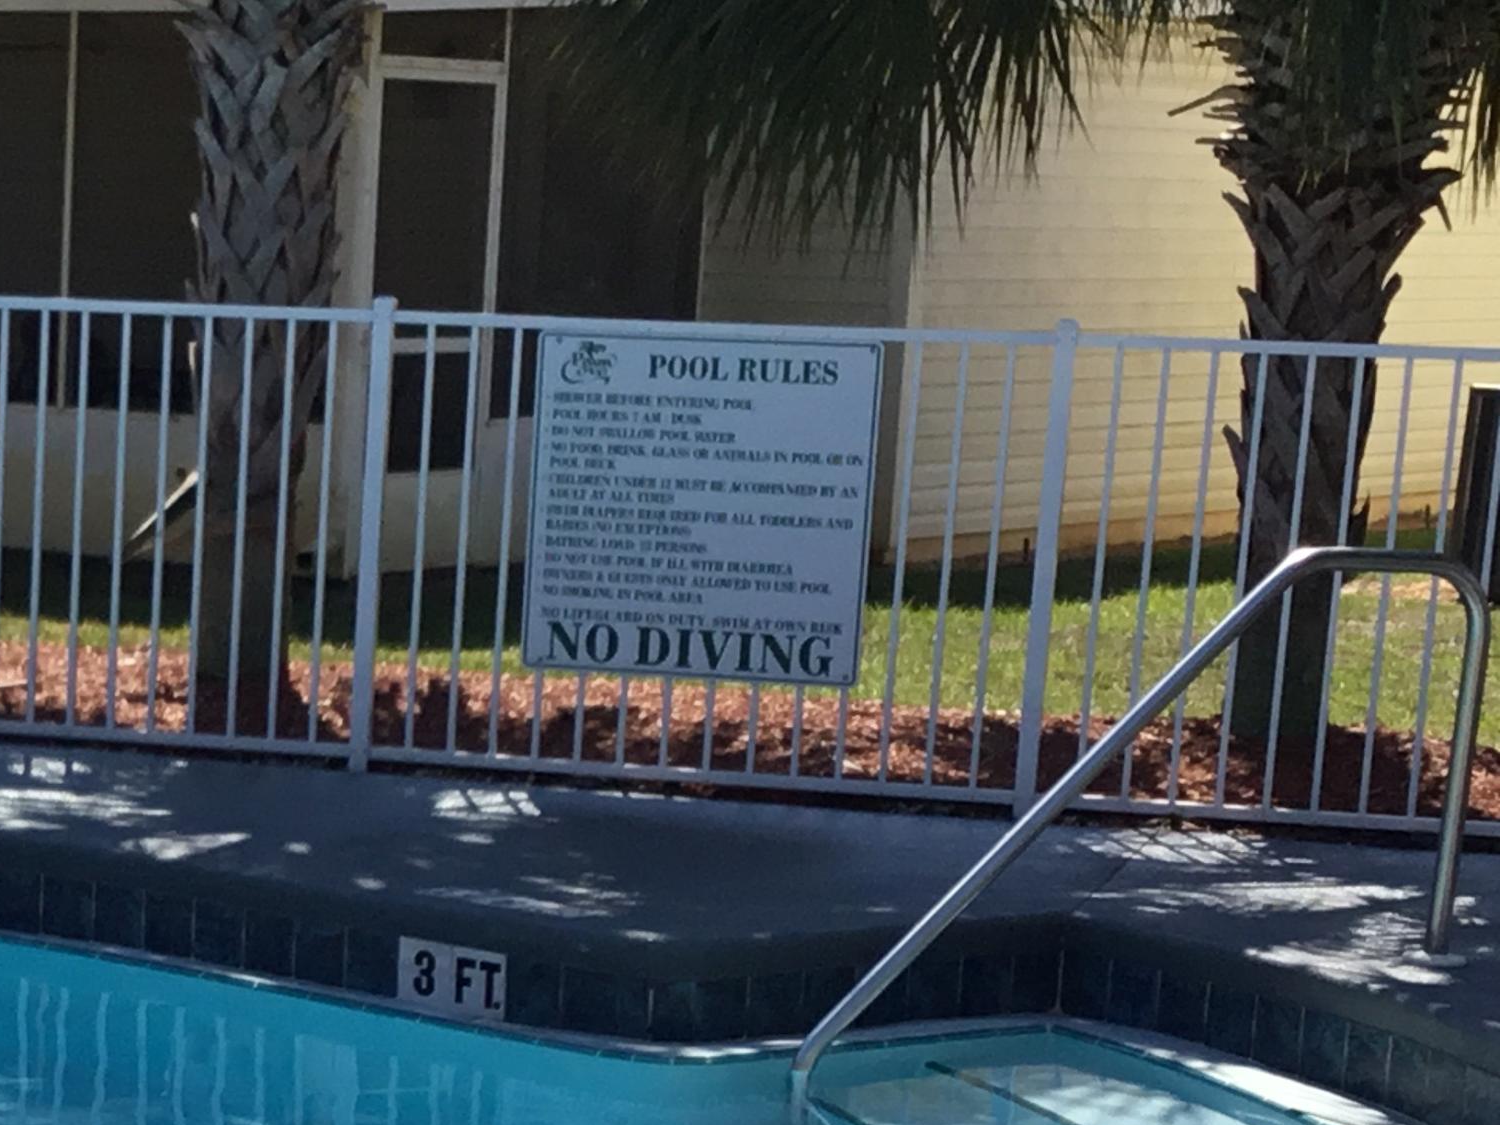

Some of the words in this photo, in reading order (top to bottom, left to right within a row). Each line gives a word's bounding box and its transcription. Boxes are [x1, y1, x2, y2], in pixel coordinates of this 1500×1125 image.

[648, 354, 729, 381] POOL
[737, 358, 839, 385] RULES
[605, 393, 651, 406] BEFORE
[656, 396, 719, 410] ENTERING
[722, 398, 752, 410] POOL
[552, 408, 581, 420] POOL
[670, 413, 702, 424] DUSK
[551, 426, 569, 436] DO
[572, 426, 595, 437] NOT
[659, 430, 690, 441] POOL
[694, 431, 736, 443] WATER
[550, 456, 579, 468] POOL
[584, 458, 616, 470] DECK
[551, 442, 567, 453] NO
[692, 448, 709, 460] OR
[713, 449, 771, 462] ANIMALS
[774, 450, 789, 463] IN
[791, 452, 822, 464] POOL
[826, 453, 843, 466] OR
[846, 453, 863, 466] ON
[548, 488, 586, 500] ADULT
[590, 489, 606, 501] AT
[610, 490, 633, 502] ALL
[636, 492, 675, 504] TIMES
[549, 474, 611, 487] CHILDREN
[614, 476, 657, 488] UNDER
[675, 479, 707, 491] MUST
[710, 480, 724, 492] BE
[728, 481, 818, 496] ACCOMPANIED
[820, 485, 835, 498] BY
[840, 486, 859, 499] AN
[703, 511, 727, 523] FOR
[731, 512, 756, 525] ALL
[759, 514, 822, 528] TODDLERS
[827, 517, 854, 530] AND
[545, 535, 598, 548] BATHING
[655, 541, 707, 553] PERSONS
[544, 552, 561, 563] DO
[564, 553, 587, 565] NOT
[591, 554, 612, 566] USE
[616, 555, 646, 568] POOL
[667, 558, 687, 570] ILL
[690, 559, 723, 572] WITH
[727, 561, 793, 575] DIARRHEA
[656, 574, 687, 587] ONLY
[691, 576, 751, 590] ALLOWED
[754, 579, 771, 591] TO
[774, 580, 797, 593] USE
[800, 581, 832, 594] POOL
[542, 585, 559, 597] NO
[561, 586, 614, 599] SMOKING
[616, 588, 632, 600] IN
[633, 590, 665, 602] POOL
[667, 591, 704, 604] AREA
[541, 606, 560, 618] NO
[563, 608, 643, 622] LIFEGUARD
[645, 612, 665, 624] ON
[711, 616, 749, 629] SWIM
[753, 617, 772, 630] AT
[773, 618, 806, 632] OWN
[809, 621, 843, 635] RISK
[546, 621, 619, 664] NO
[633, 626, 834, 677] DIVING
[413, 949, 436, 997] 3
